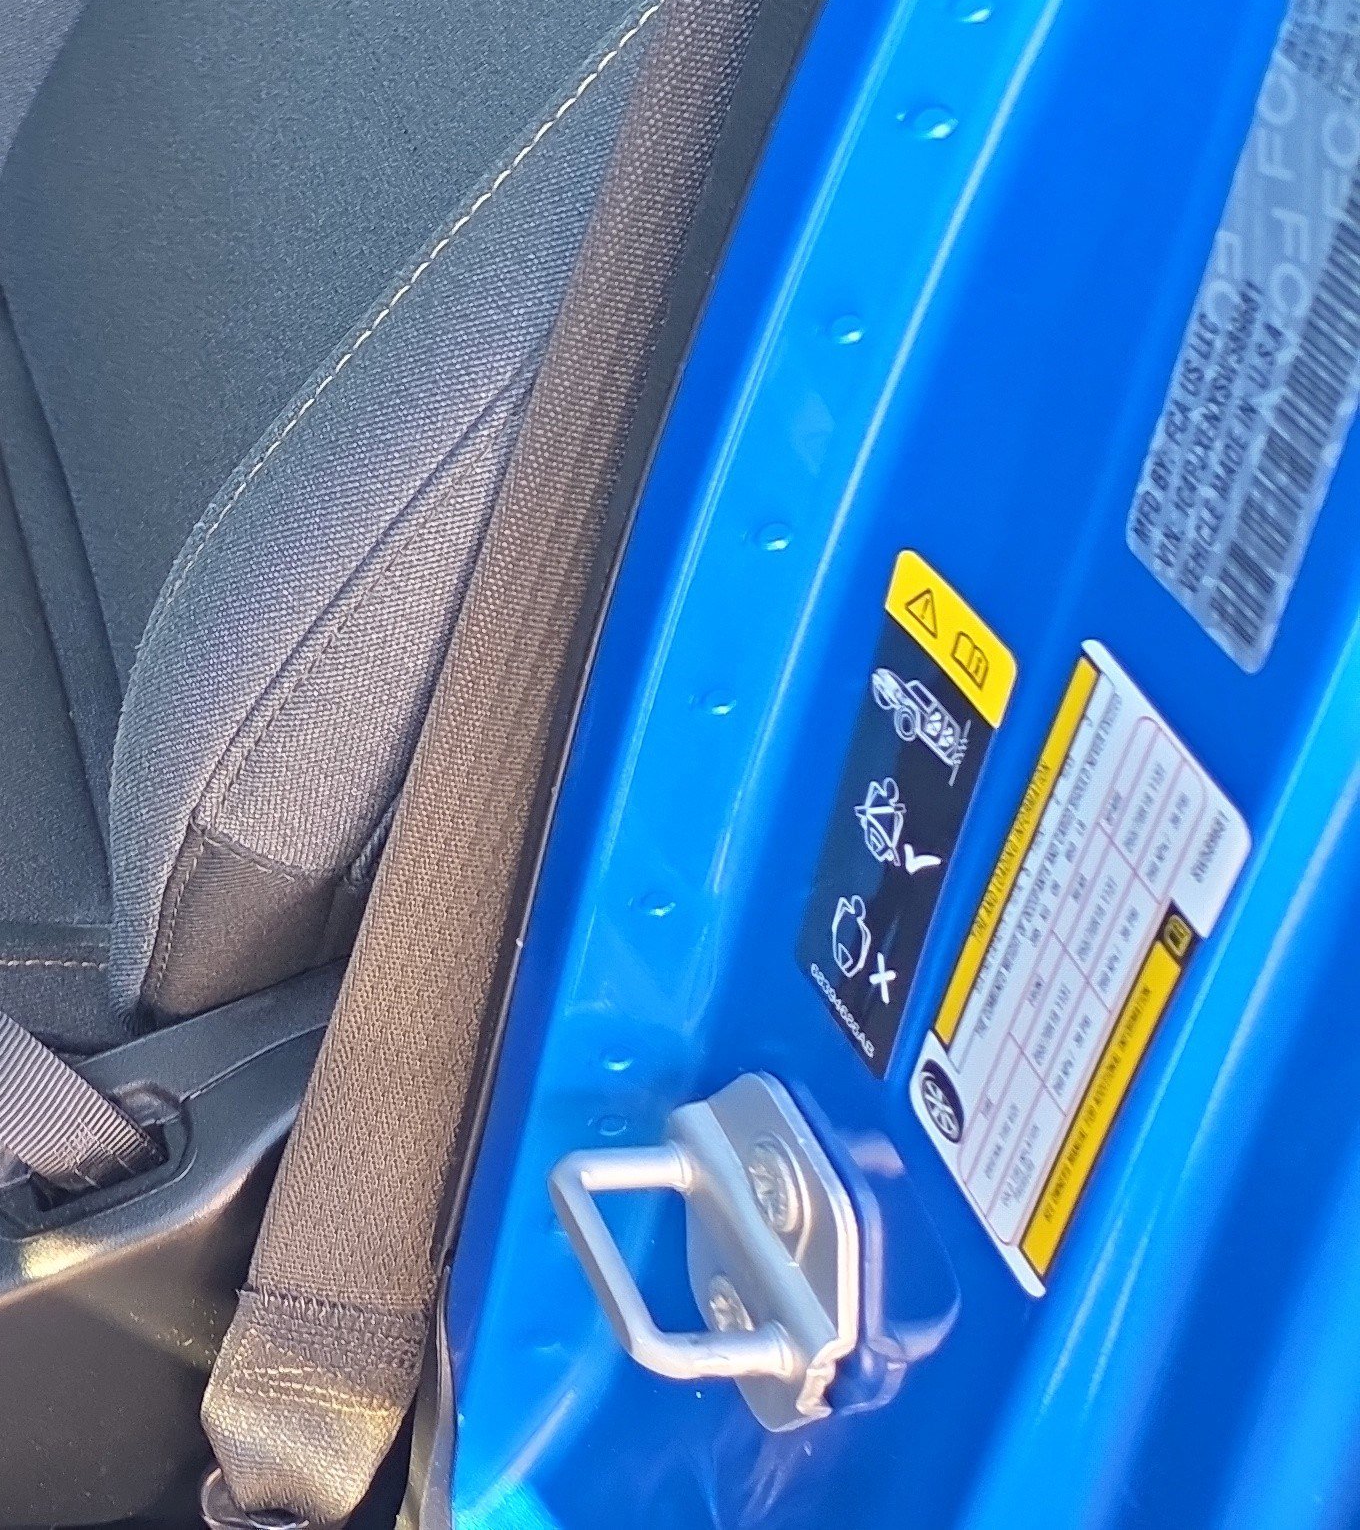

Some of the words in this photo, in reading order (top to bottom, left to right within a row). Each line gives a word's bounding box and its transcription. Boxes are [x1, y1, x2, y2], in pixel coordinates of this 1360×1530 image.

[1190, 311, 1219, 360] LLC
[1180, 358, 1204, 397] US
[1165, 397, 1192, 447] FCA
[1132, 489, 1162, 546] MFD
[1178, 497, 1225, 595] VEHICLE
[1211, 429, 1249, 499] MADE
[1238, 396, 1258, 422] IN
